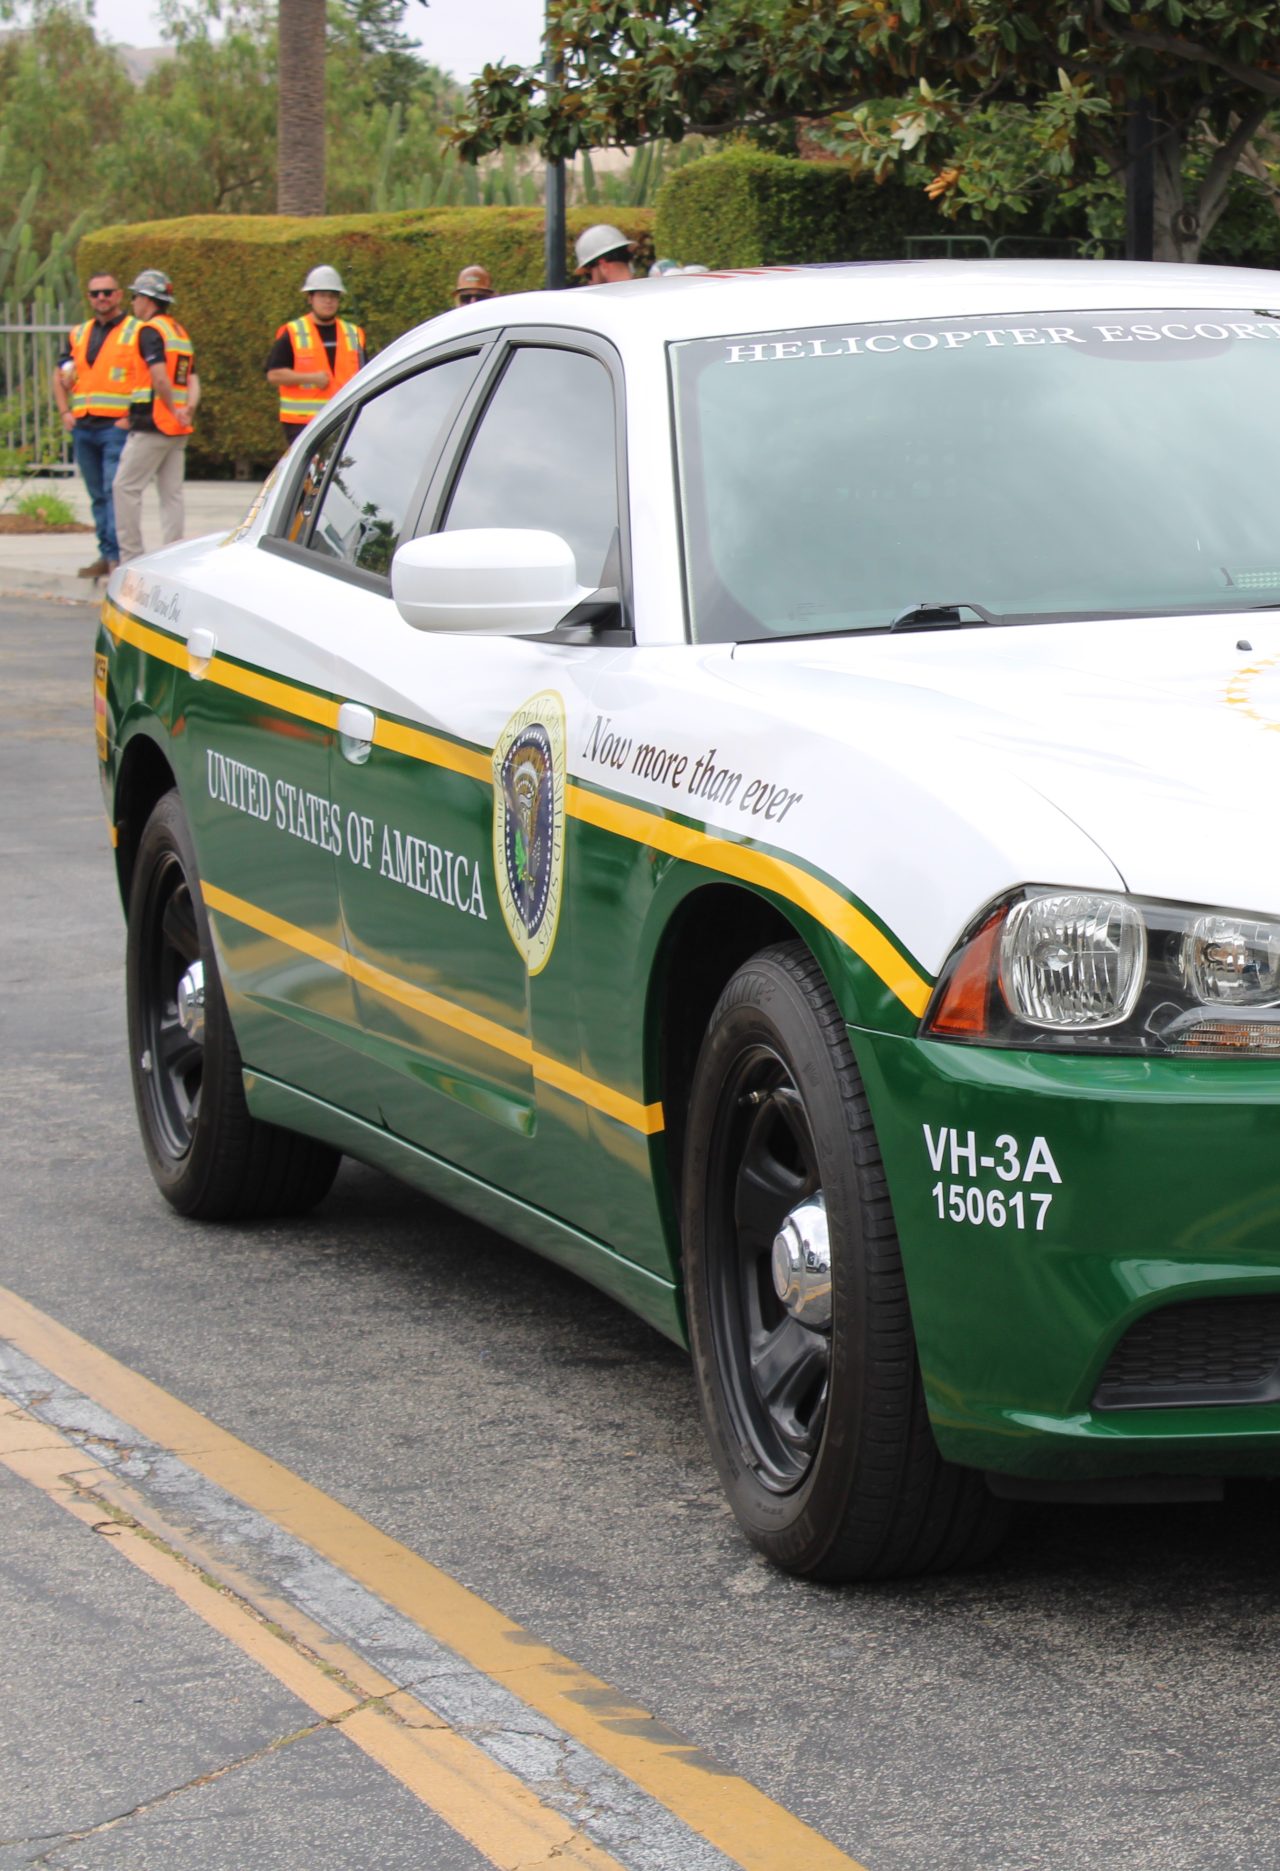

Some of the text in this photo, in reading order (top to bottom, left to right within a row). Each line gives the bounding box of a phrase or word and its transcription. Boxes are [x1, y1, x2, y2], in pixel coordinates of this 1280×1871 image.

[725, 328, 1086, 363] HELICOPTER
[582, 715, 804, 823] Now more than ever
[206, 750, 488, 920] UNITED STATES OF AMERICA
[922, 1123, 1063, 1184] VH-3A
[932, 1181, 1053, 1231] 150617
